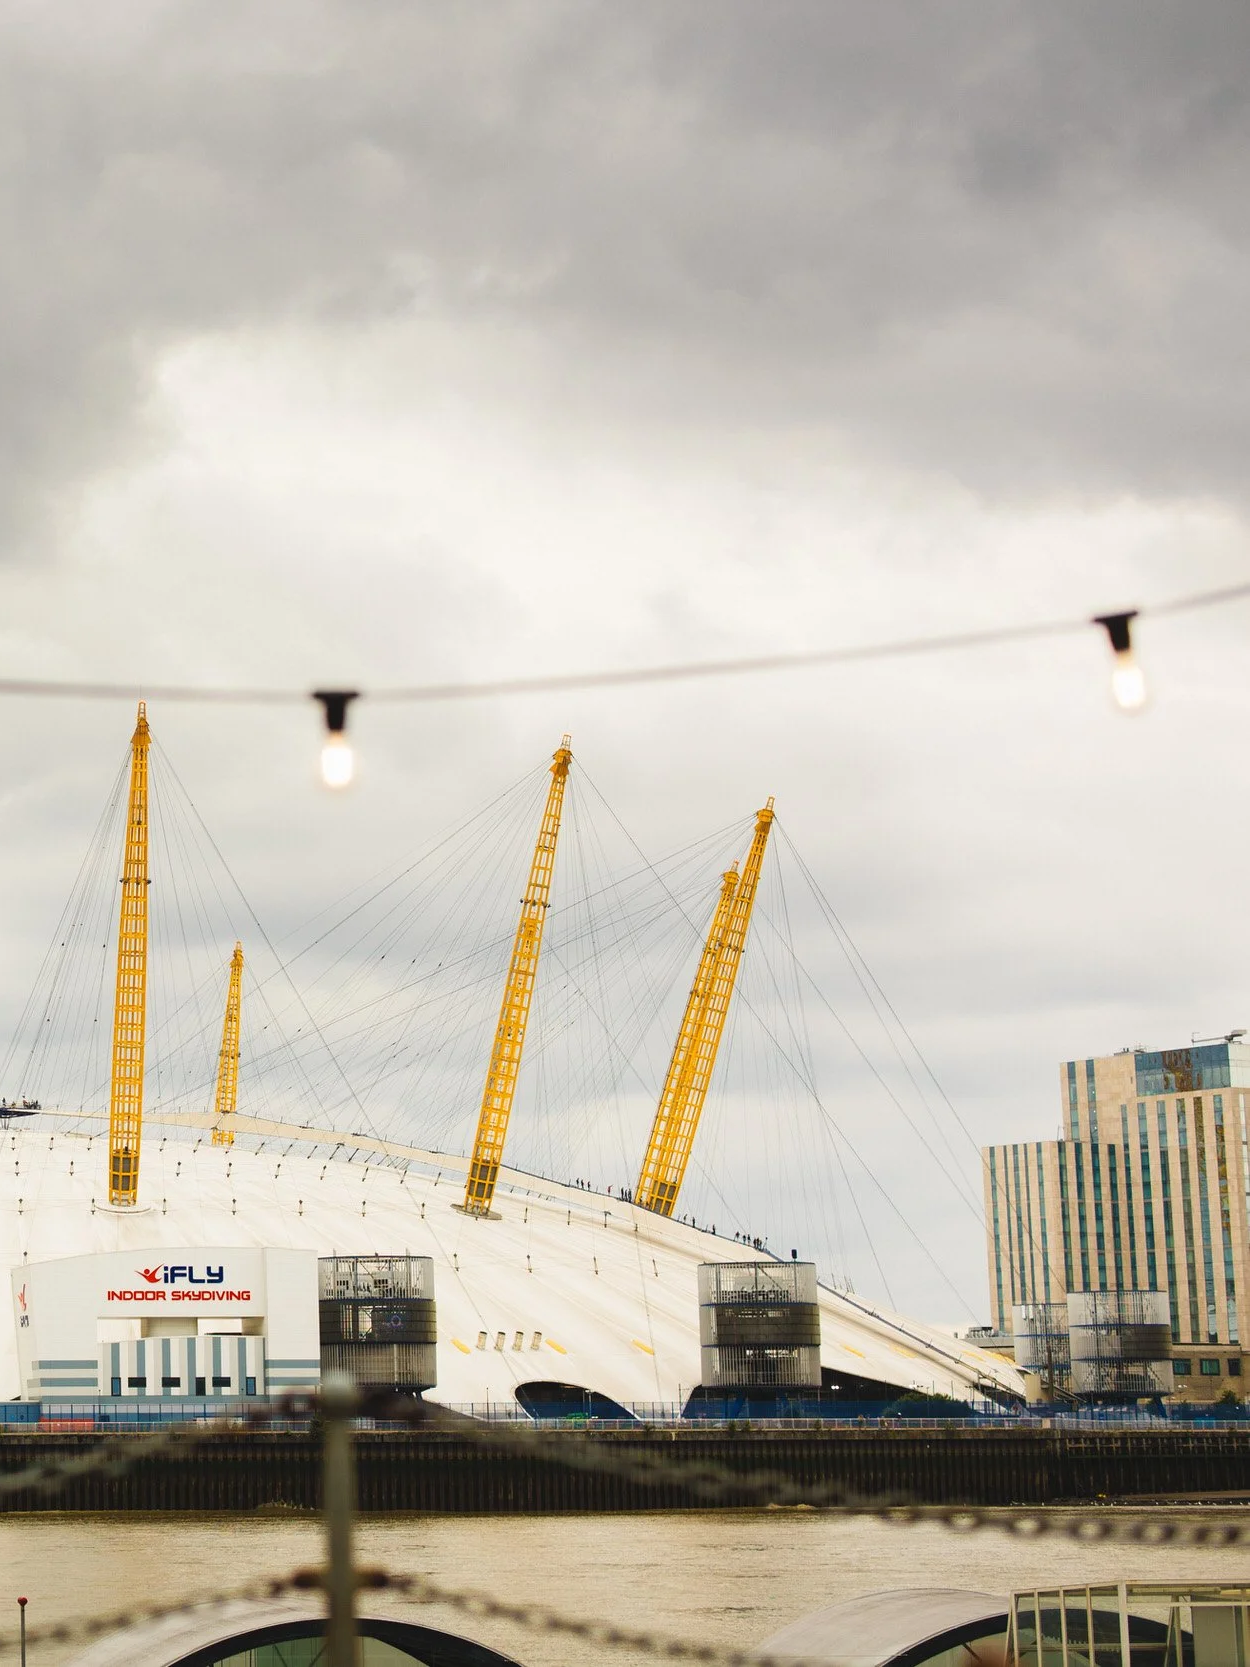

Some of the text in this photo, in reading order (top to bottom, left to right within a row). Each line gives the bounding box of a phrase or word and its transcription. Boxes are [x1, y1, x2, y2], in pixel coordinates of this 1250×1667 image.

[163, 1266, 224, 1284] iFLY
[107, 1290, 251, 1301] INDOOR SKYDIVING
